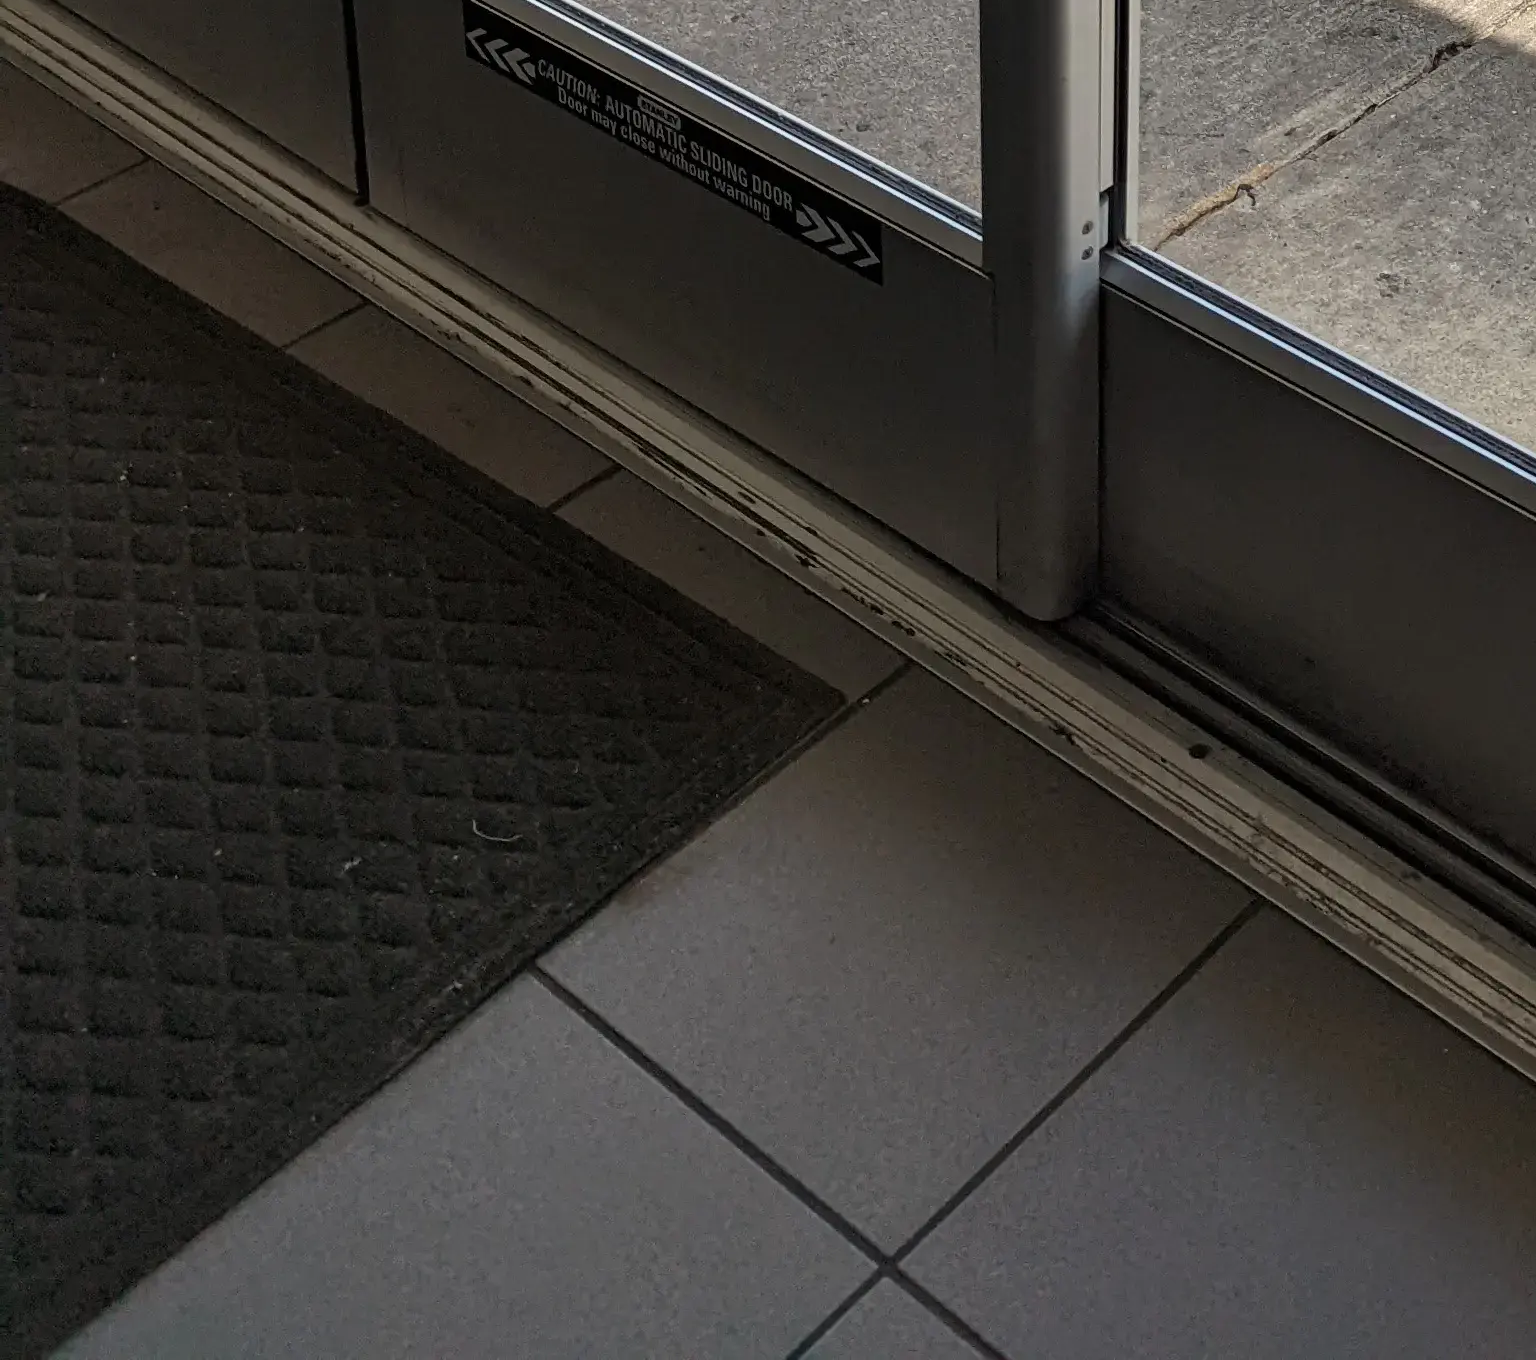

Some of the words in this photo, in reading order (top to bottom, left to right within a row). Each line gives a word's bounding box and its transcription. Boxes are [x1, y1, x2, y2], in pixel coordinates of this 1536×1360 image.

[538, 59, 601, 107] CAUTION:
[605, 95, 688, 154] AUTOMATIC
[690, 141, 748, 188] SLIDING
[751, 174, 793, 212] DOOR
[558, 86, 588, 116] Door
[591, 109, 617, 136] may
[620, 125, 656, 154] close
[659, 145, 710, 184] without
[713, 176, 770, 221] warning
